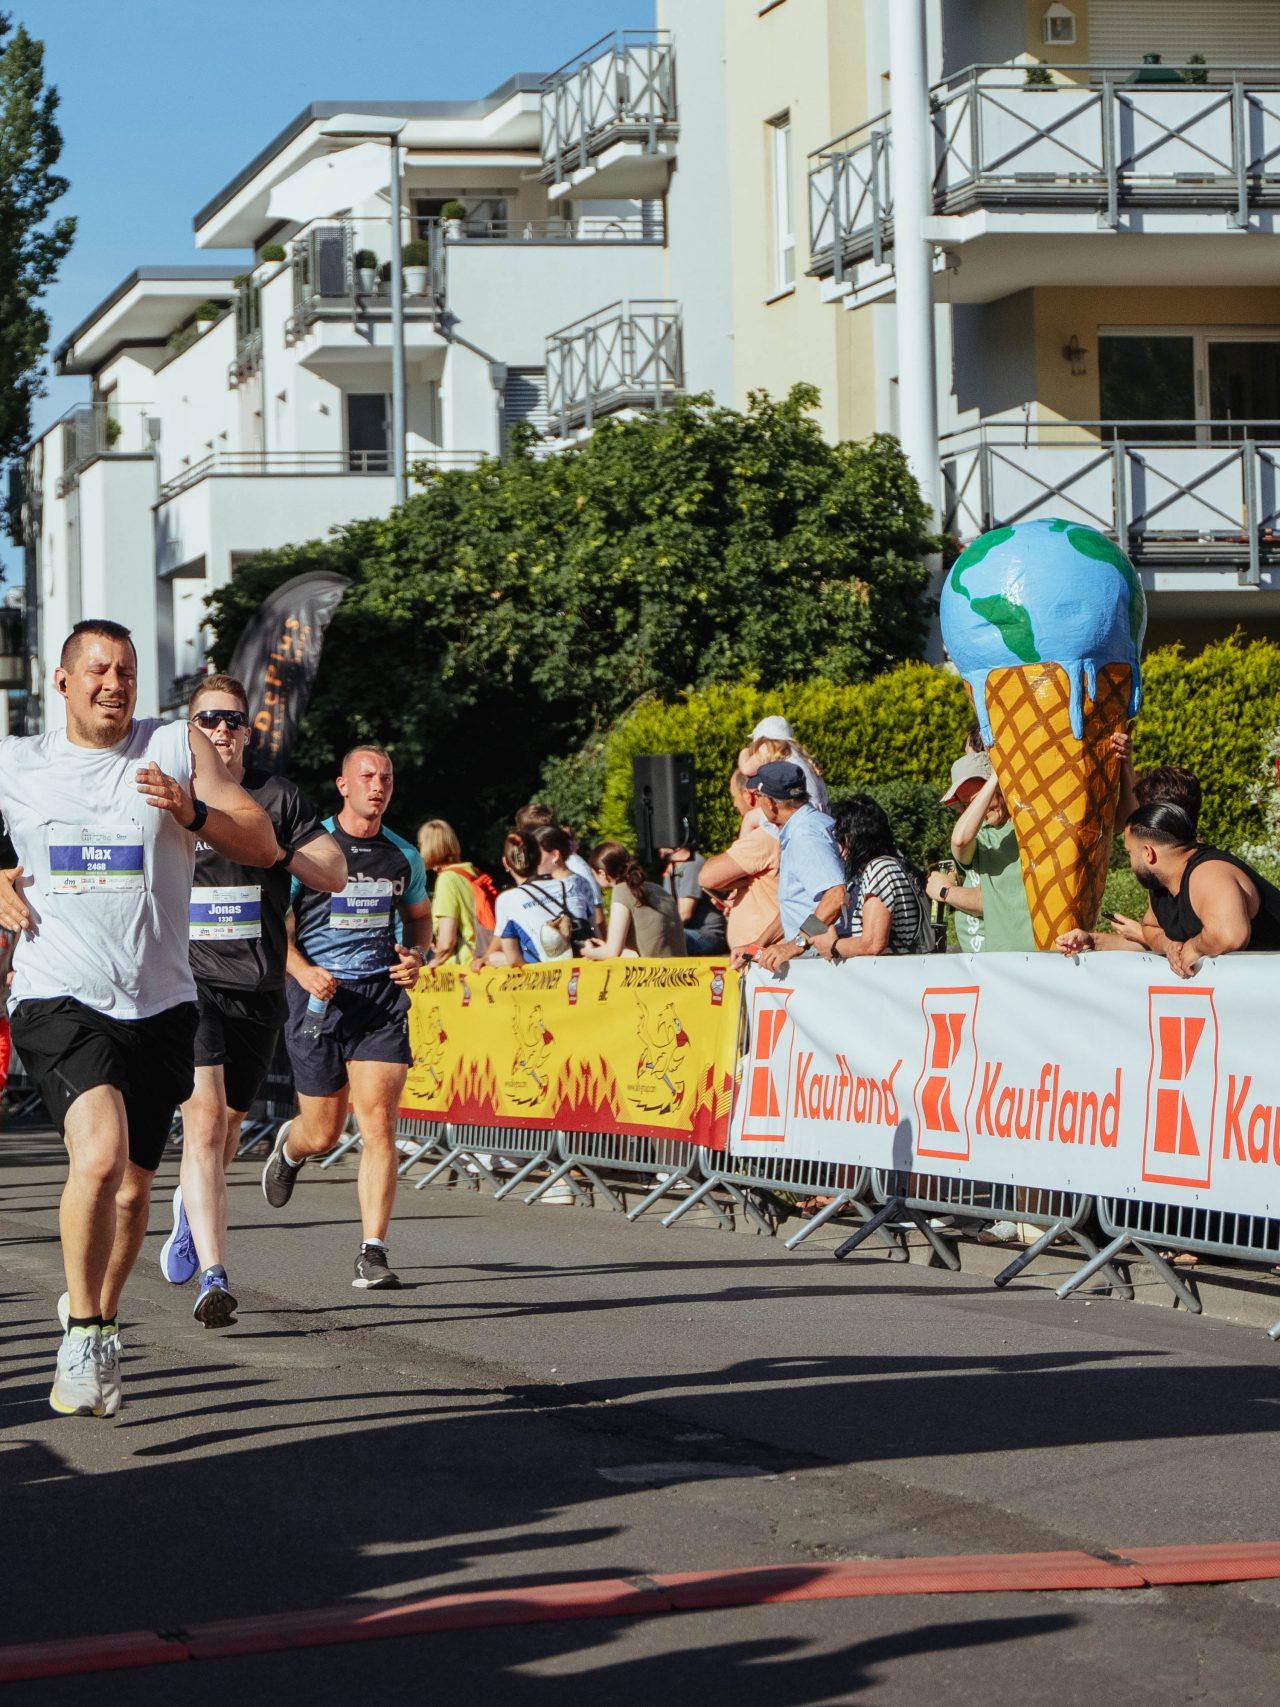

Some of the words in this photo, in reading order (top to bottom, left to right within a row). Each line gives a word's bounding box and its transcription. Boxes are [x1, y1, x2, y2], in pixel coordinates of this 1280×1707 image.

[81, 846, 112, 860] Max
[87, 862, 106, 871] 2468
[346, 897, 380, 907] Werner
[208, 903, 242, 915] Jonas
[794, 1054, 903, 1127] Kaufland
[976, 1061, 1123, 1148] Kaufland
